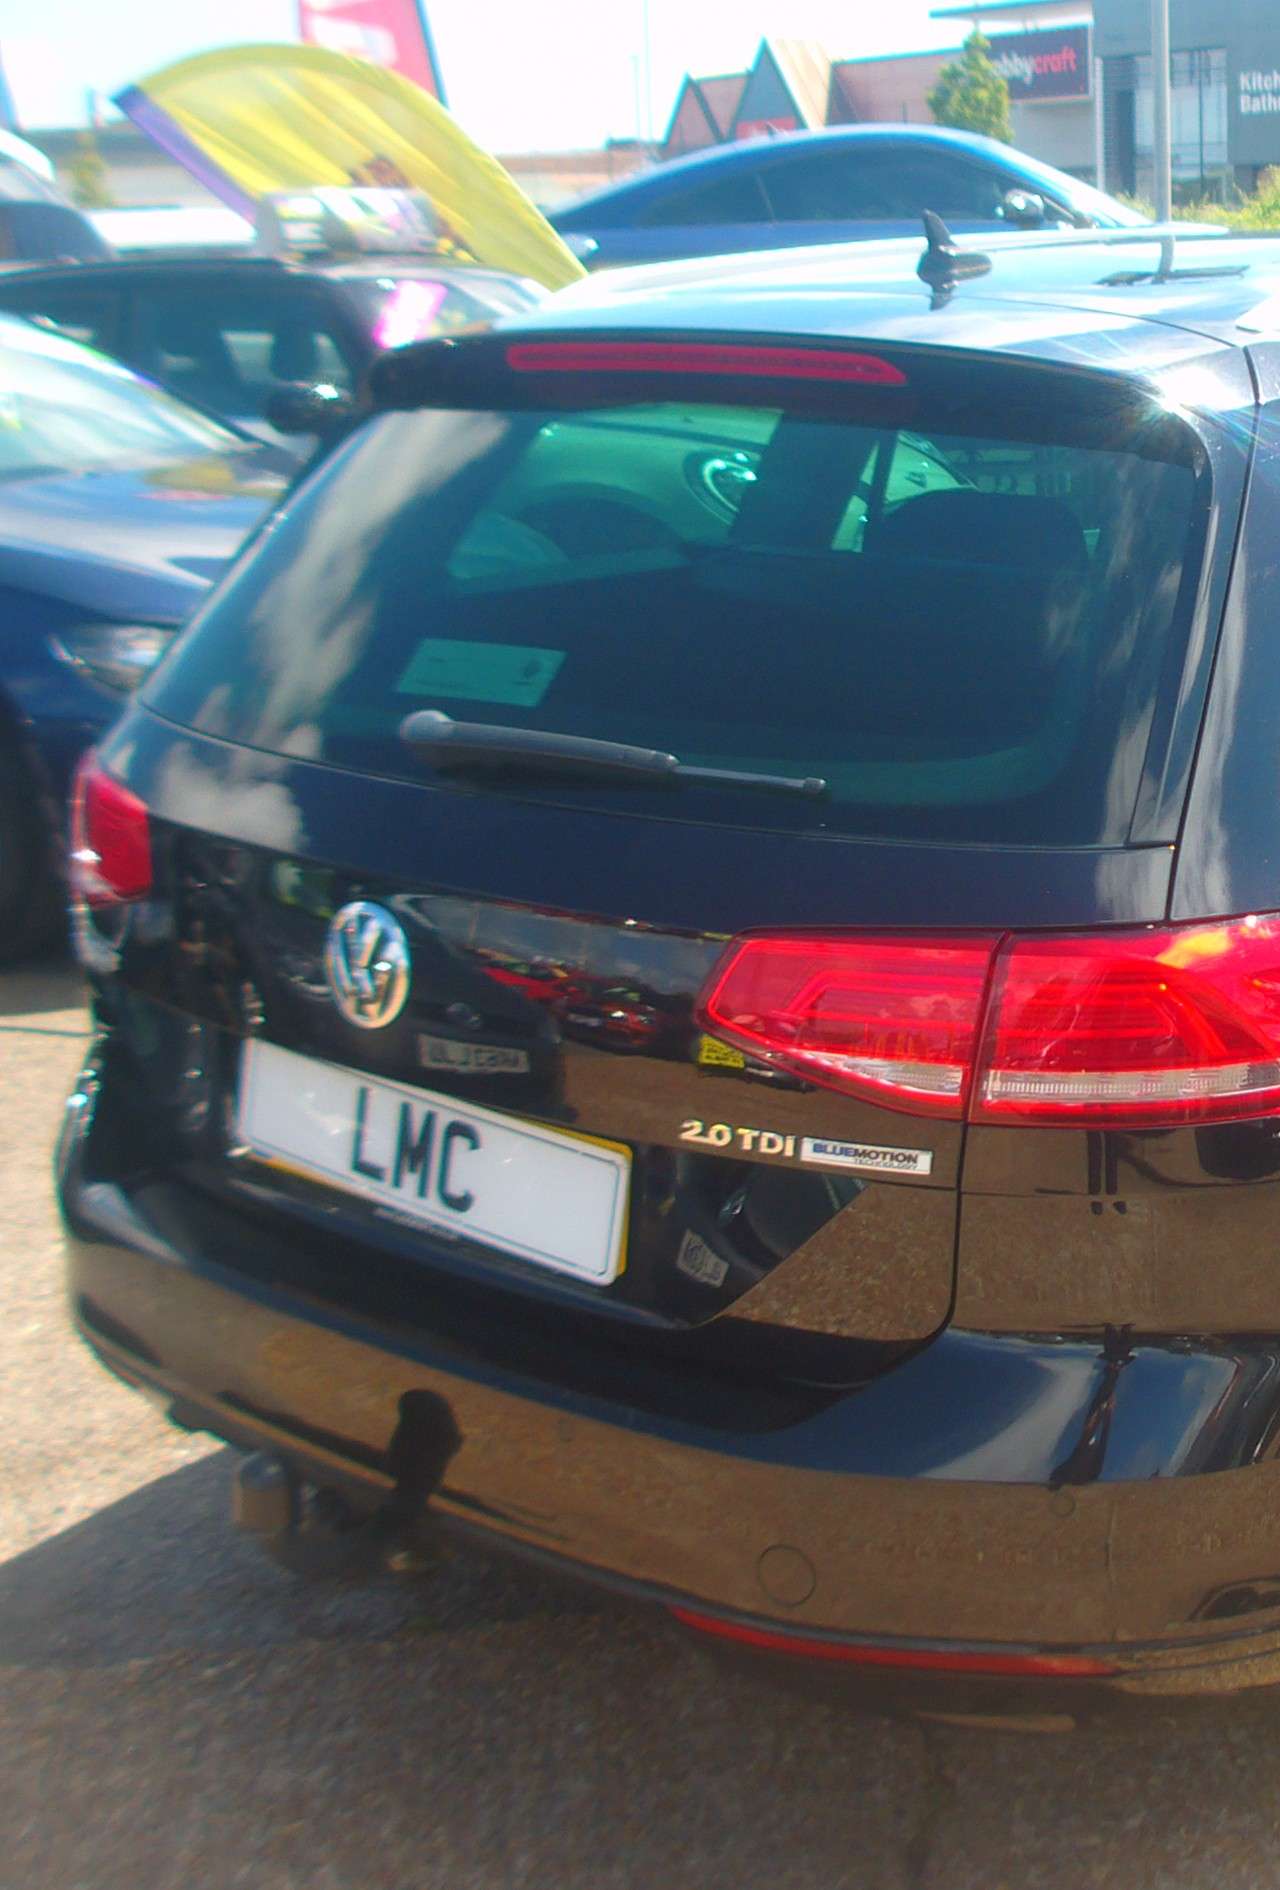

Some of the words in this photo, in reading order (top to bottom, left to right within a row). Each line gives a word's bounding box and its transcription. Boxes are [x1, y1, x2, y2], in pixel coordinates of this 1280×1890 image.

[990, 46, 1076, 84] obbycraft
[351, 1086, 480, 1213] LMC
[679, 1120, 732, 1147] 2.0
[737, 1127, 797, 1157] TDI
[812, 1143, 919, 1164] BLUEMOTION
